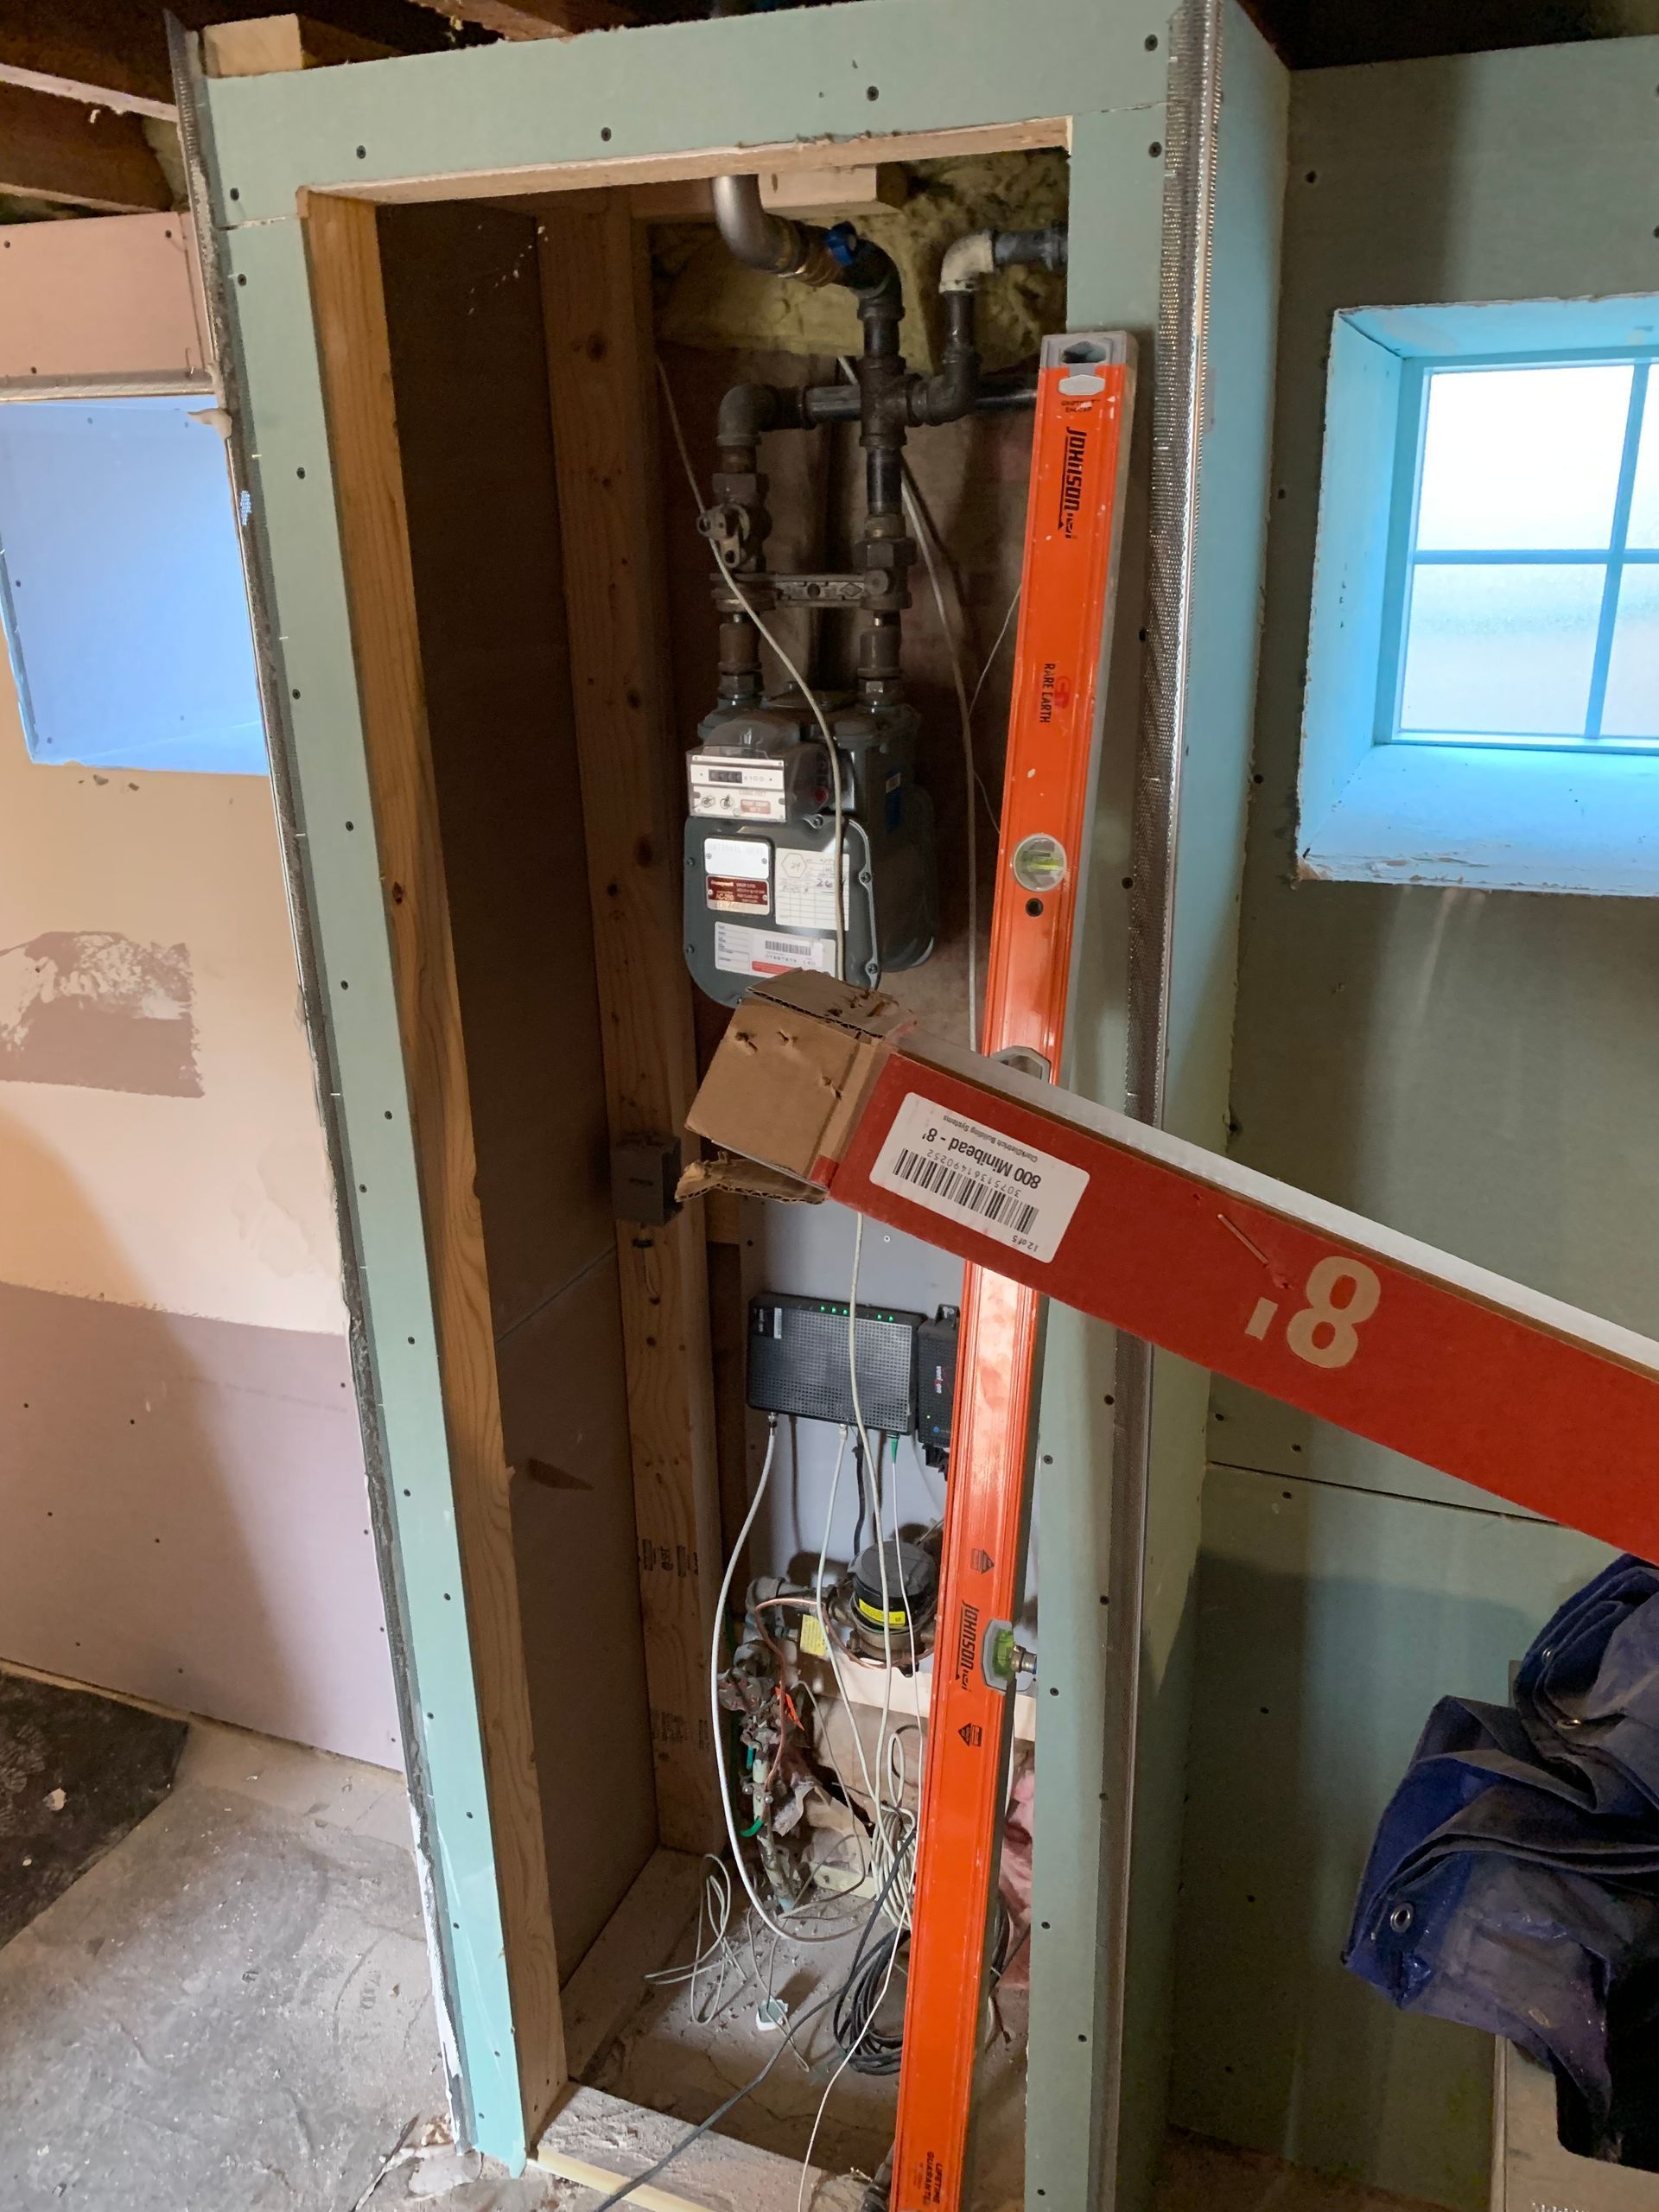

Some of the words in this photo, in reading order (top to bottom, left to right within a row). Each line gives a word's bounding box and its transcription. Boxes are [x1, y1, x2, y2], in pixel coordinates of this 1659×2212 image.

[1064, 426, 1087, 512] JOHNSON
[1043, 663, 1056, 690] RARE
[943, 1115, 969, 1132] Systems
[969, 1126, 996, 1144] Building
[948, 1136, 1010, 1177] Minibead
[997, 1139, 1038, 1163] ClarkDietrich
[926, 1148, 1021, 1198] 30751361490252
[1014, 1167, 1042, 1189] 800
[1011, 1234, 1017, 1243] 5
[1019, 1237, 1027, 1247] of
[961, 1599, 980, 1670] JOHNSON
[933, 2163, 942, 2204] LIFETIME
